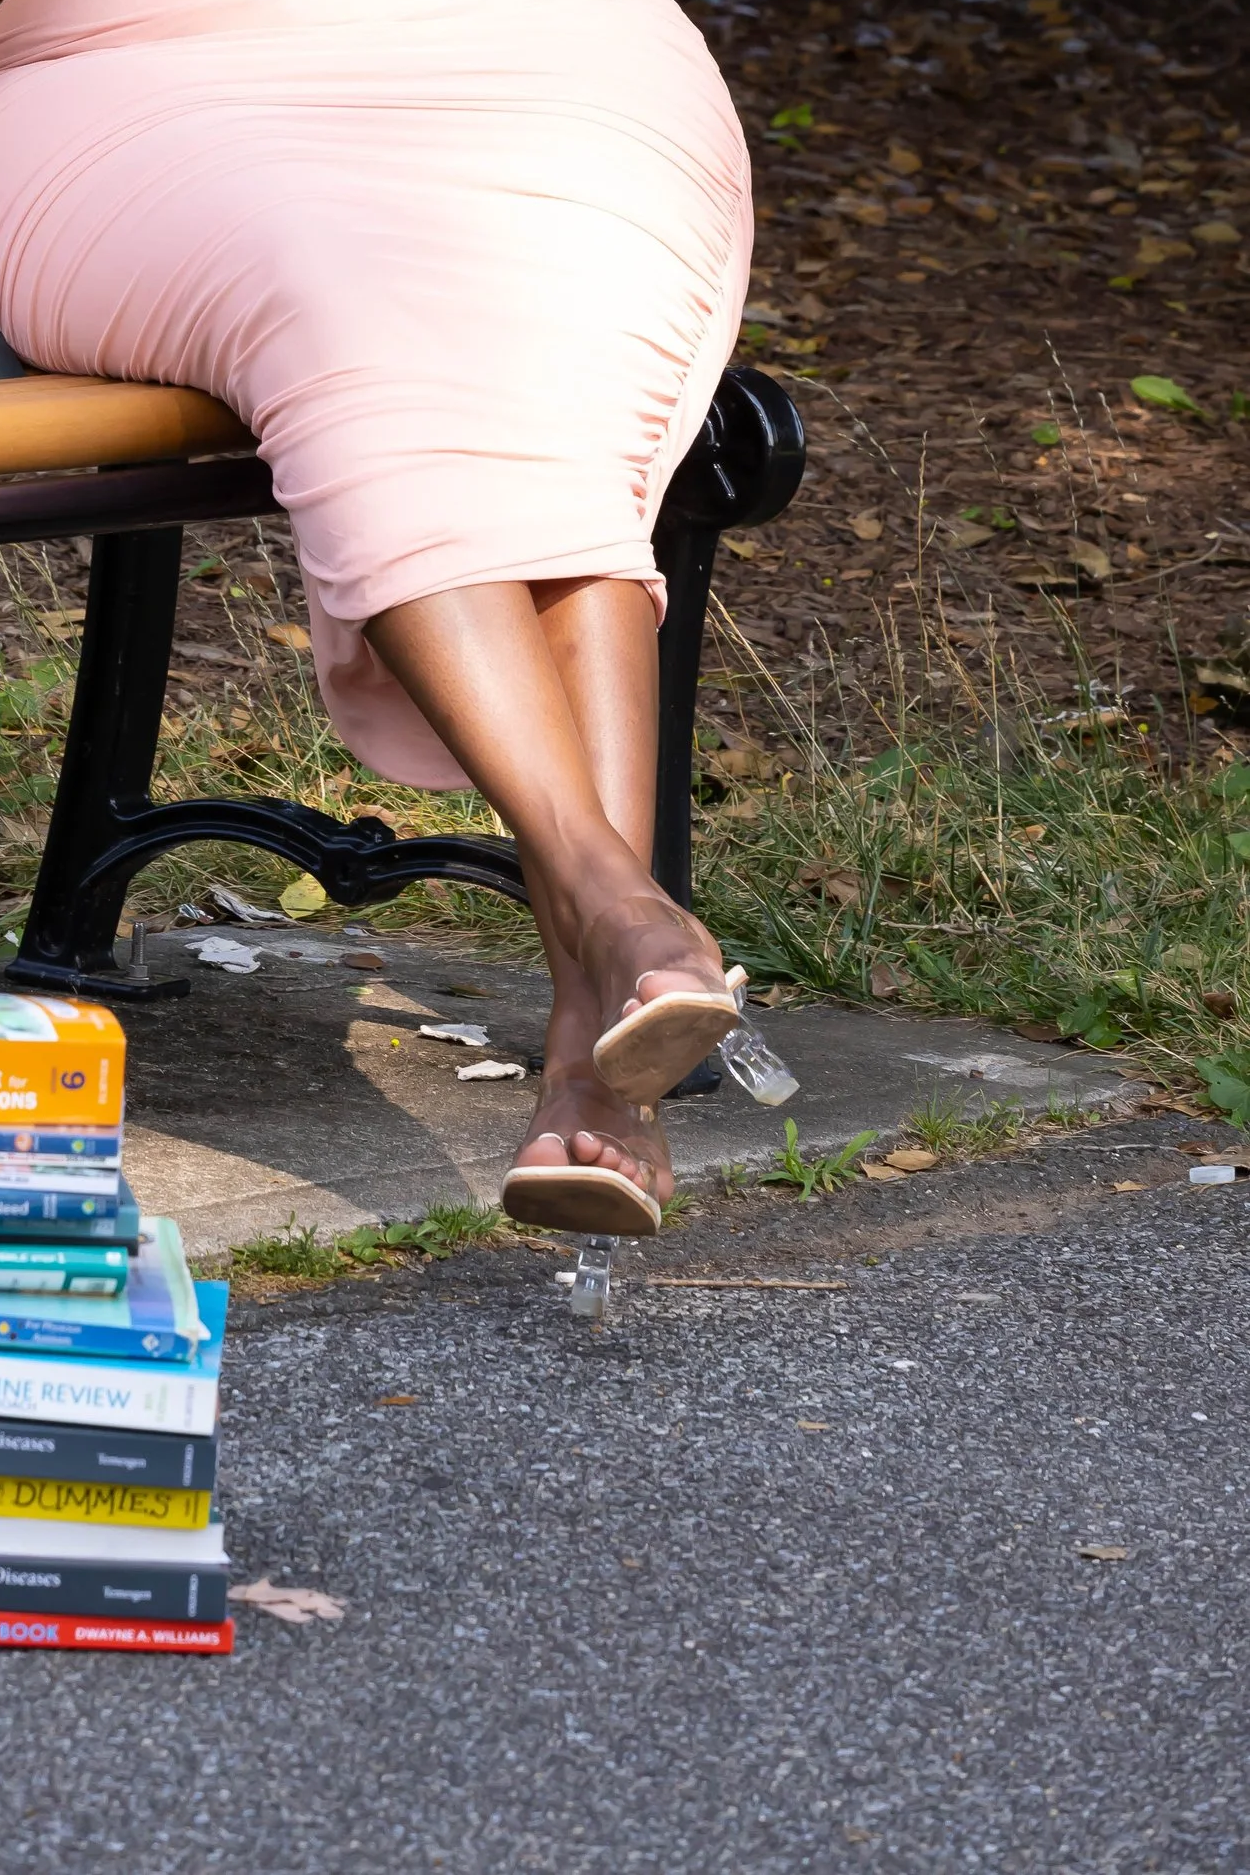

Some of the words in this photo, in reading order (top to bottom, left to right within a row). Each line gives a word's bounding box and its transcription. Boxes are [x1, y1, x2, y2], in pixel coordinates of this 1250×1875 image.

[40, 1381, 132, 1409] REVIEW
[13, 1480, 173, 1520] DUMMIES
[74, 1626, 131, 1644] DWAYNE
[151, 1629, 220, 1646] WILLIAMS
